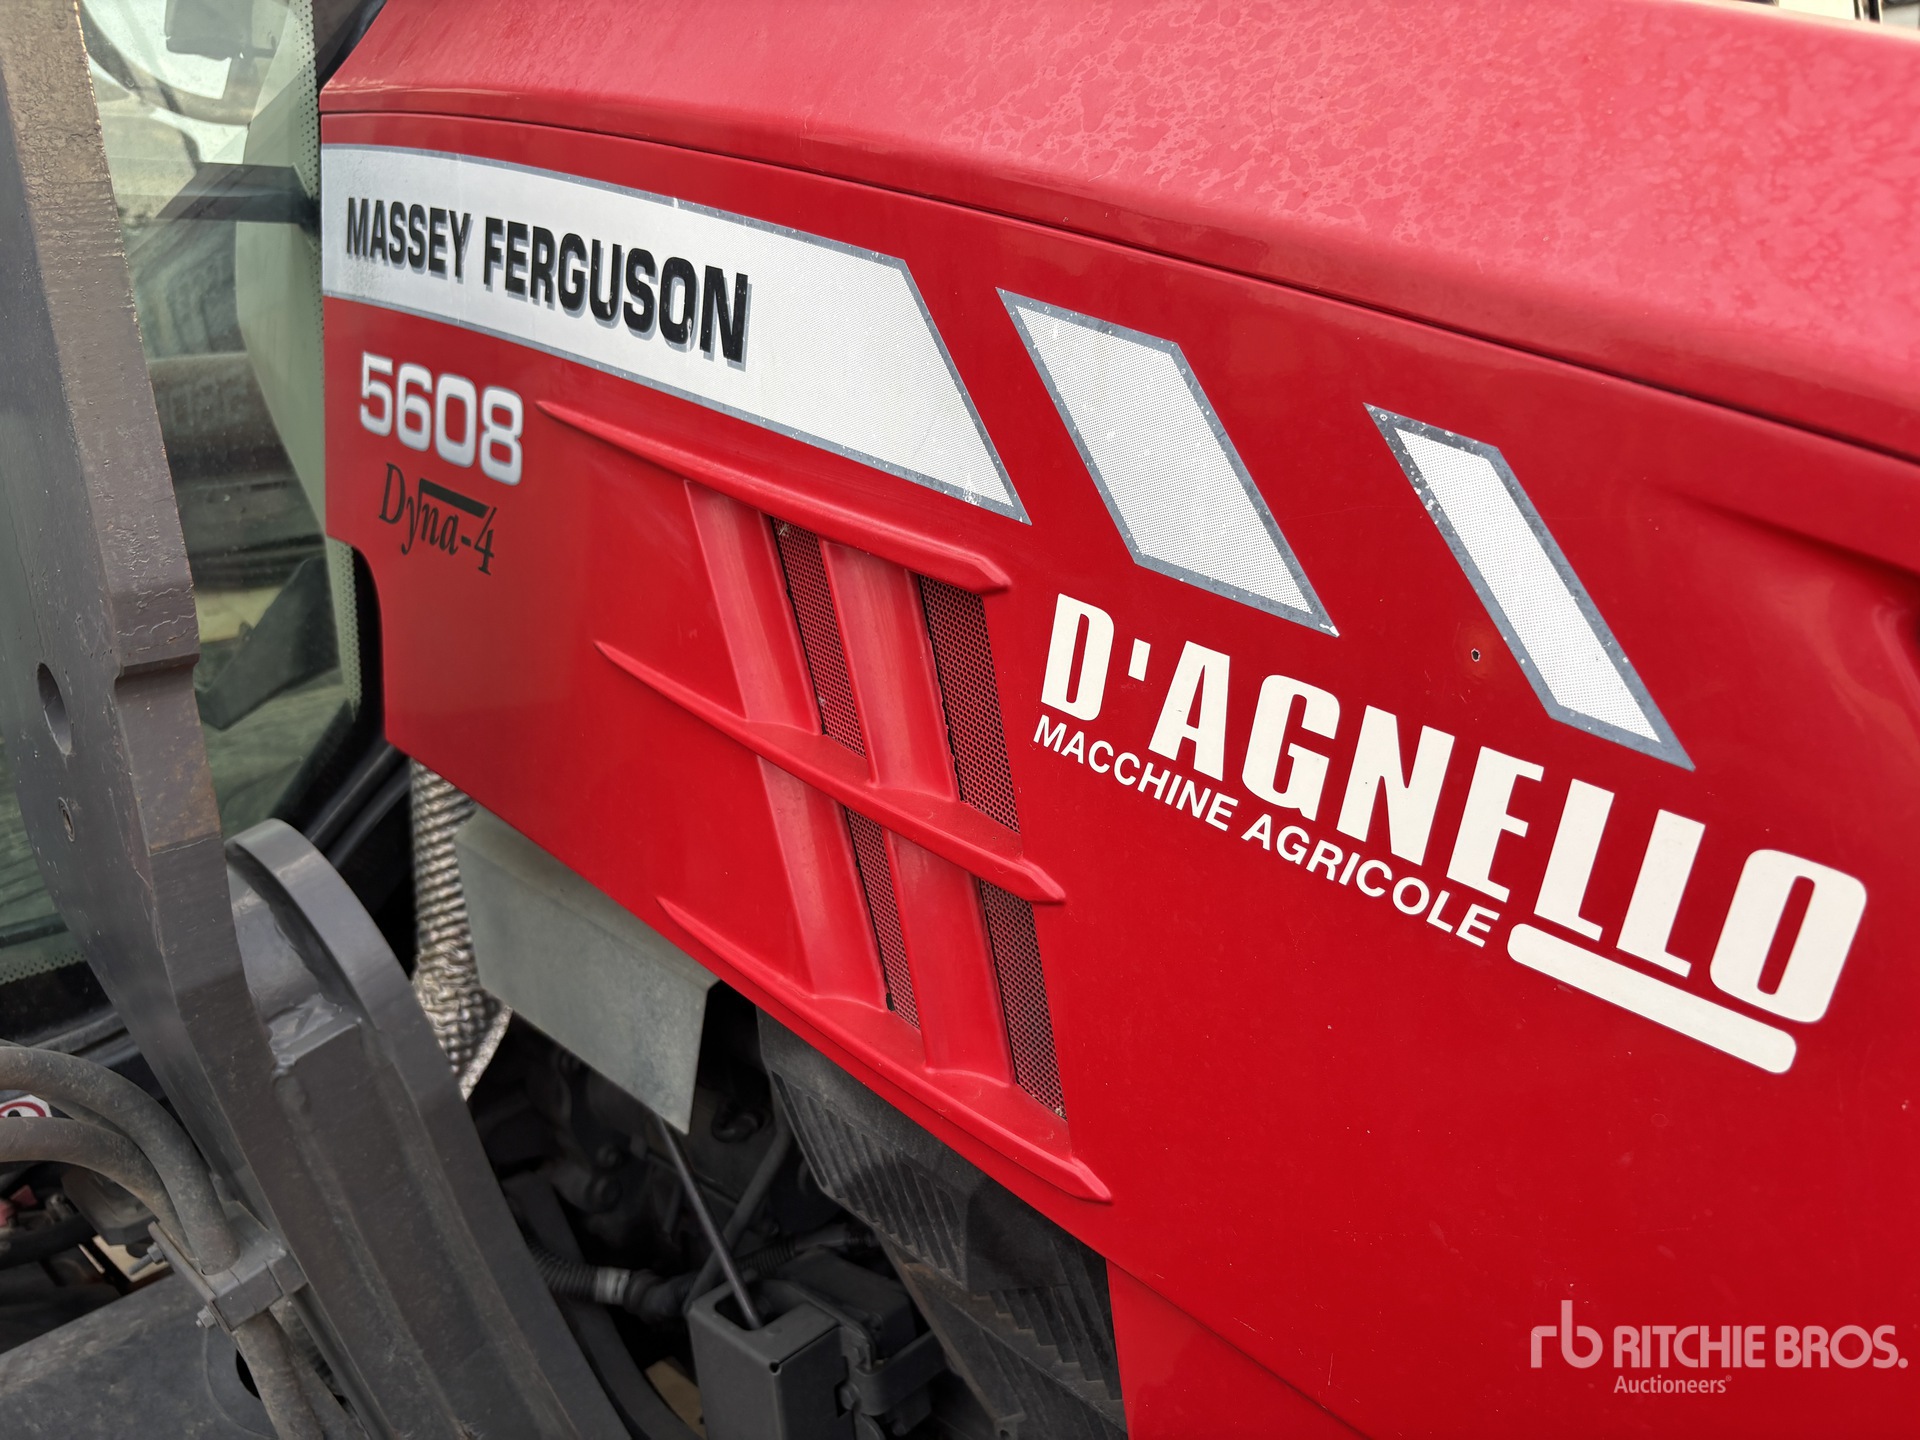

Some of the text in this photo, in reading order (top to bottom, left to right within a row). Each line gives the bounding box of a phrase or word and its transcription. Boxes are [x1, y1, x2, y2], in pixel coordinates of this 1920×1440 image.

[346, 197, 752, 371] MASSEY FERGUSON
[360, 352, 524, 486] 5608
[379, 463, 498, 575] Dyna-4
[1033, 715, 1501, 948] MACCHINE AGRICOLE
[1041, 593, 1867, 1023] D'AGNELLO
